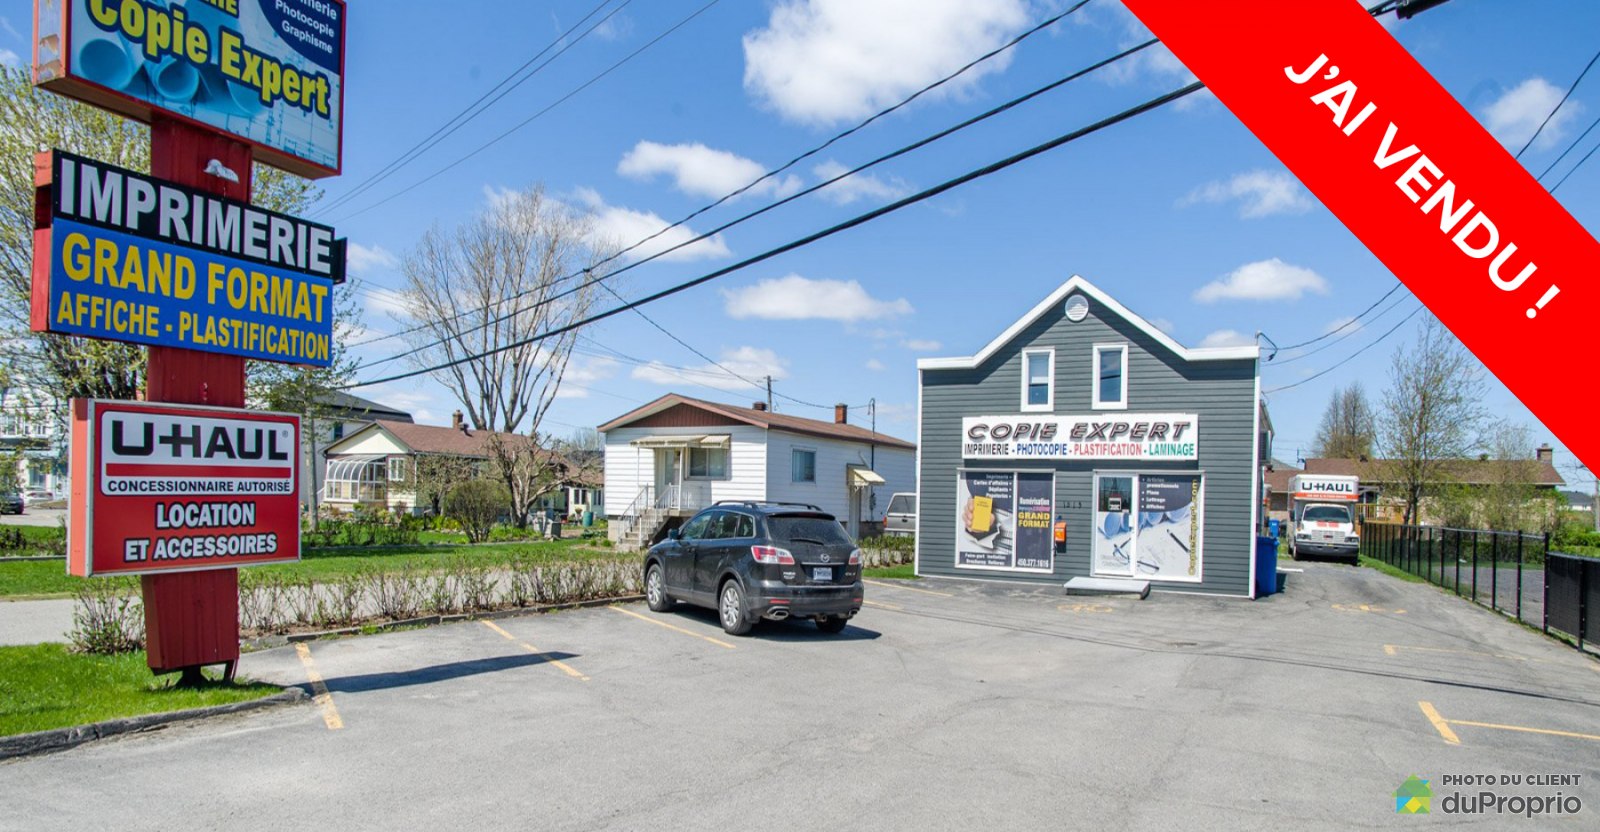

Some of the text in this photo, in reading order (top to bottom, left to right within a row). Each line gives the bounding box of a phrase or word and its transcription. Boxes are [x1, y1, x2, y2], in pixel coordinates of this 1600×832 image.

[275, 0, 335, 37] Photocopie
[301, 0, 337, 20] merie
[281, 20, 333, 54] Graphisme
[90, 0, 329, 116] Copie Expert
[59, 157, 332, 274] IMPRIMERIE
[62, 233, 328, 323] GRAND FORMAT
[57, 291, 159, 337] AFFICHE
[178, 311, 329, 360] PLASTIFICATION
[111, 420, 288, 460] U-HAUL
[968, 422, 1190, 441] COPIE EXPERT
[964, 443, 1009, 455] IMPRIMERIE
[1017, 443, 1067, 456] PHOTOCOPIE
[1074, 443, 1142, 456] PLASTIFICATION
[1149, 443, 1194, 456] LAMINAGE
[108, 479, 290, 493] CONCESSIONNAIRE AUTORISÉ
[1302, 482, 1352, 492] U-HAUL
[156, 503, 255, 529] LOCATION
[1018, 511, 1051, 520] GRAND
[1018, 520, 1050, 528] FORMAT
[125, 533, 277, 561] ET ACCESSOIRES
